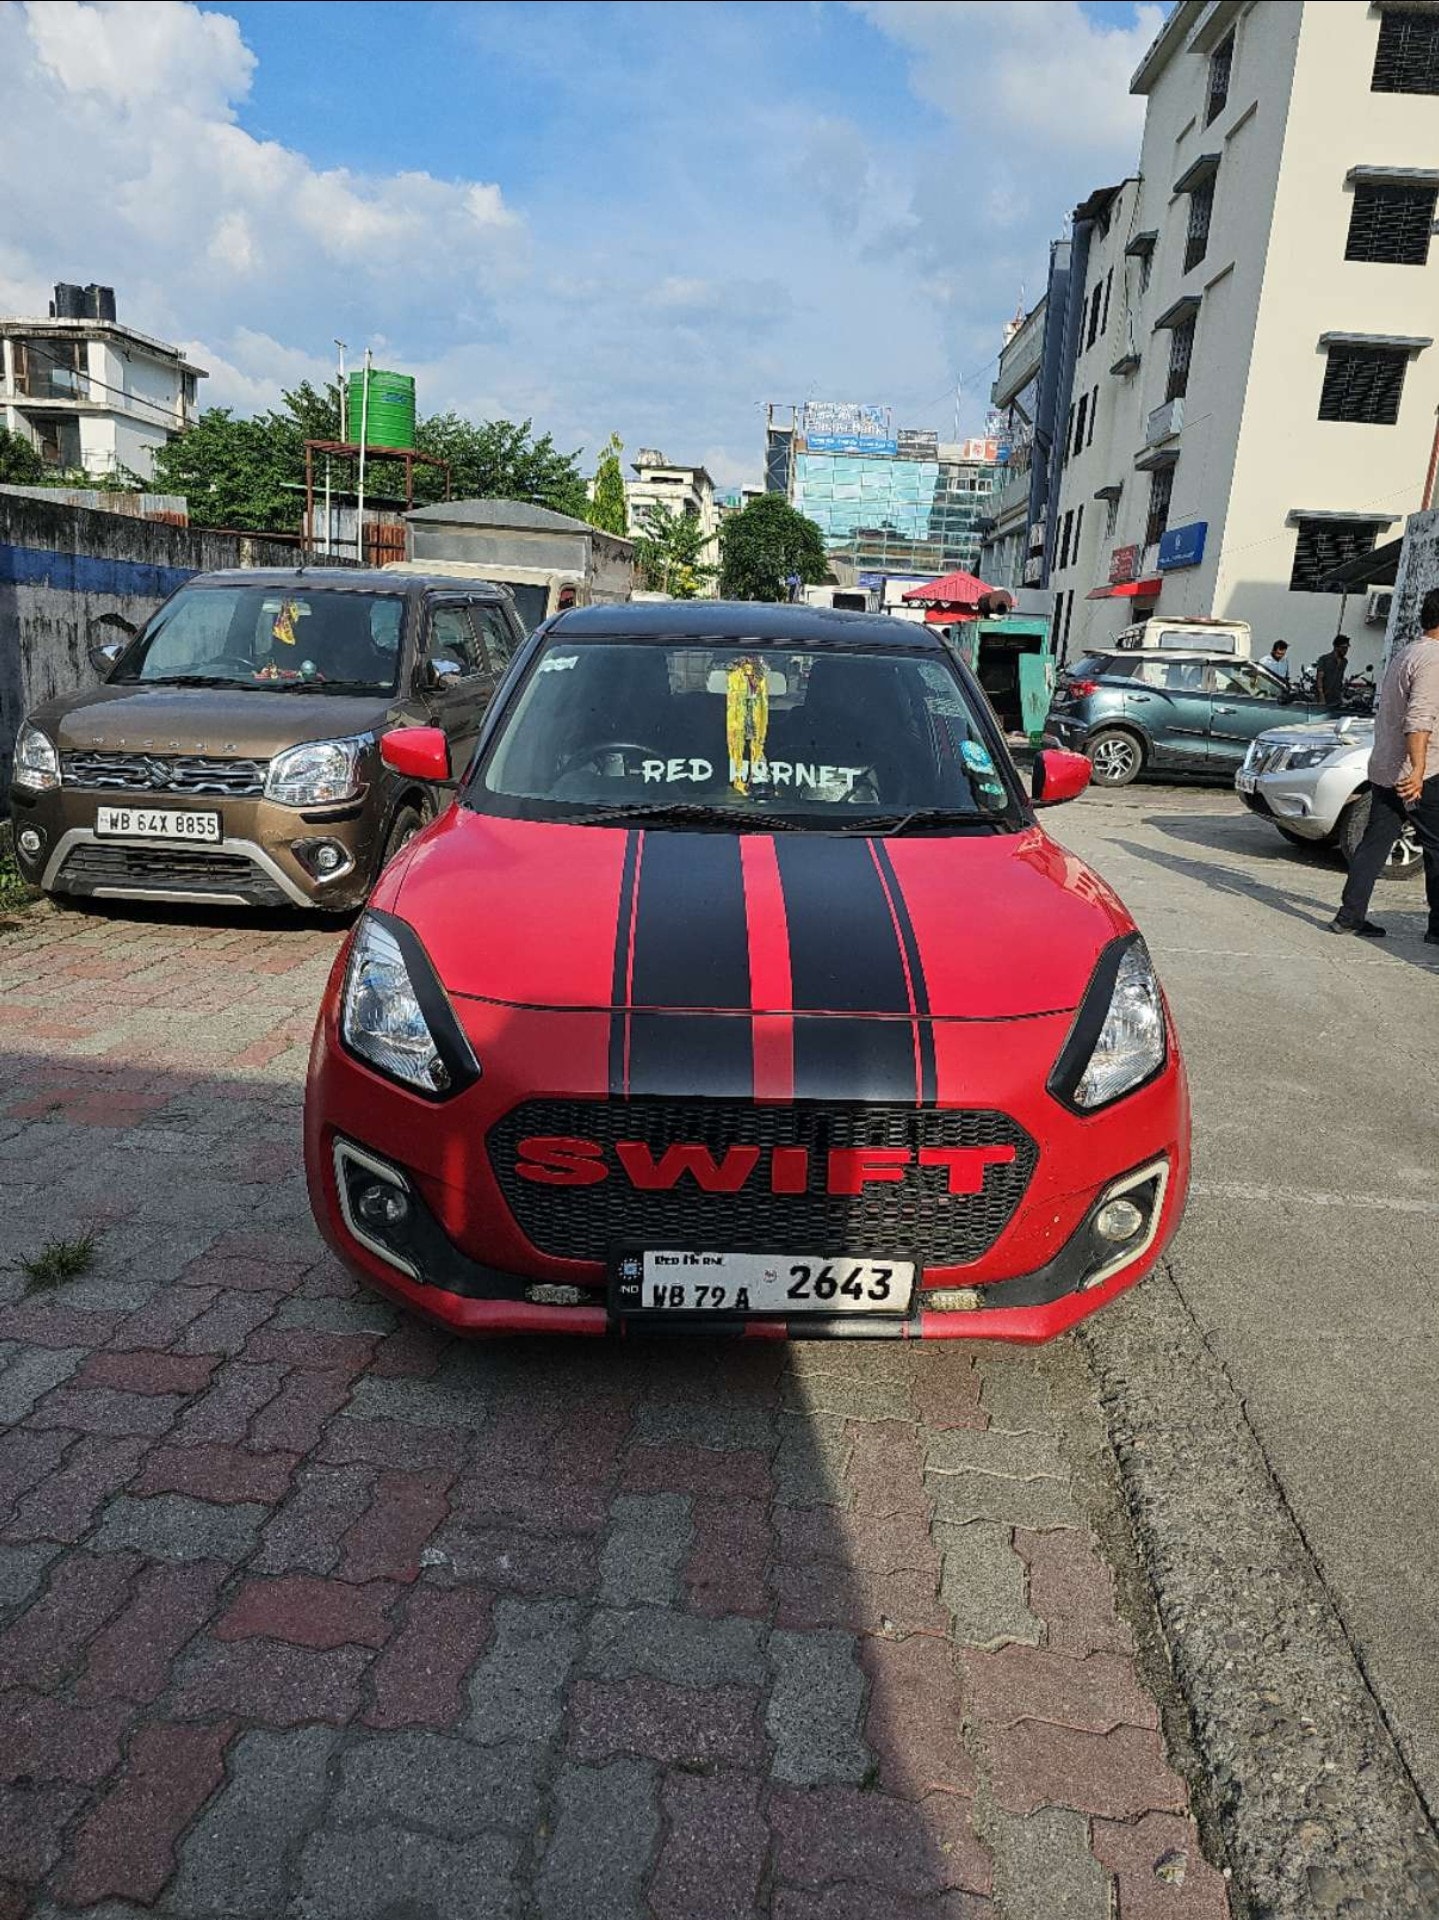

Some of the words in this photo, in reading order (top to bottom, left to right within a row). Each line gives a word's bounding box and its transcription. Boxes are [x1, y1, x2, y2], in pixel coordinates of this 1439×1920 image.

[642, 758, 713, 783] RED
[110, 812, 130, 831] WB
[138, 814, 168, 832] 64X
[176, 816, 216, 834] 8855
[514, 1136, 1016, 1194] SWIFT
[653, 1284, 685, 1307] WB
[694, 1285, 726, 1307] 79
[735, 1287, 750, 1309] A
[787, 1265, 893, 1300] 2643
